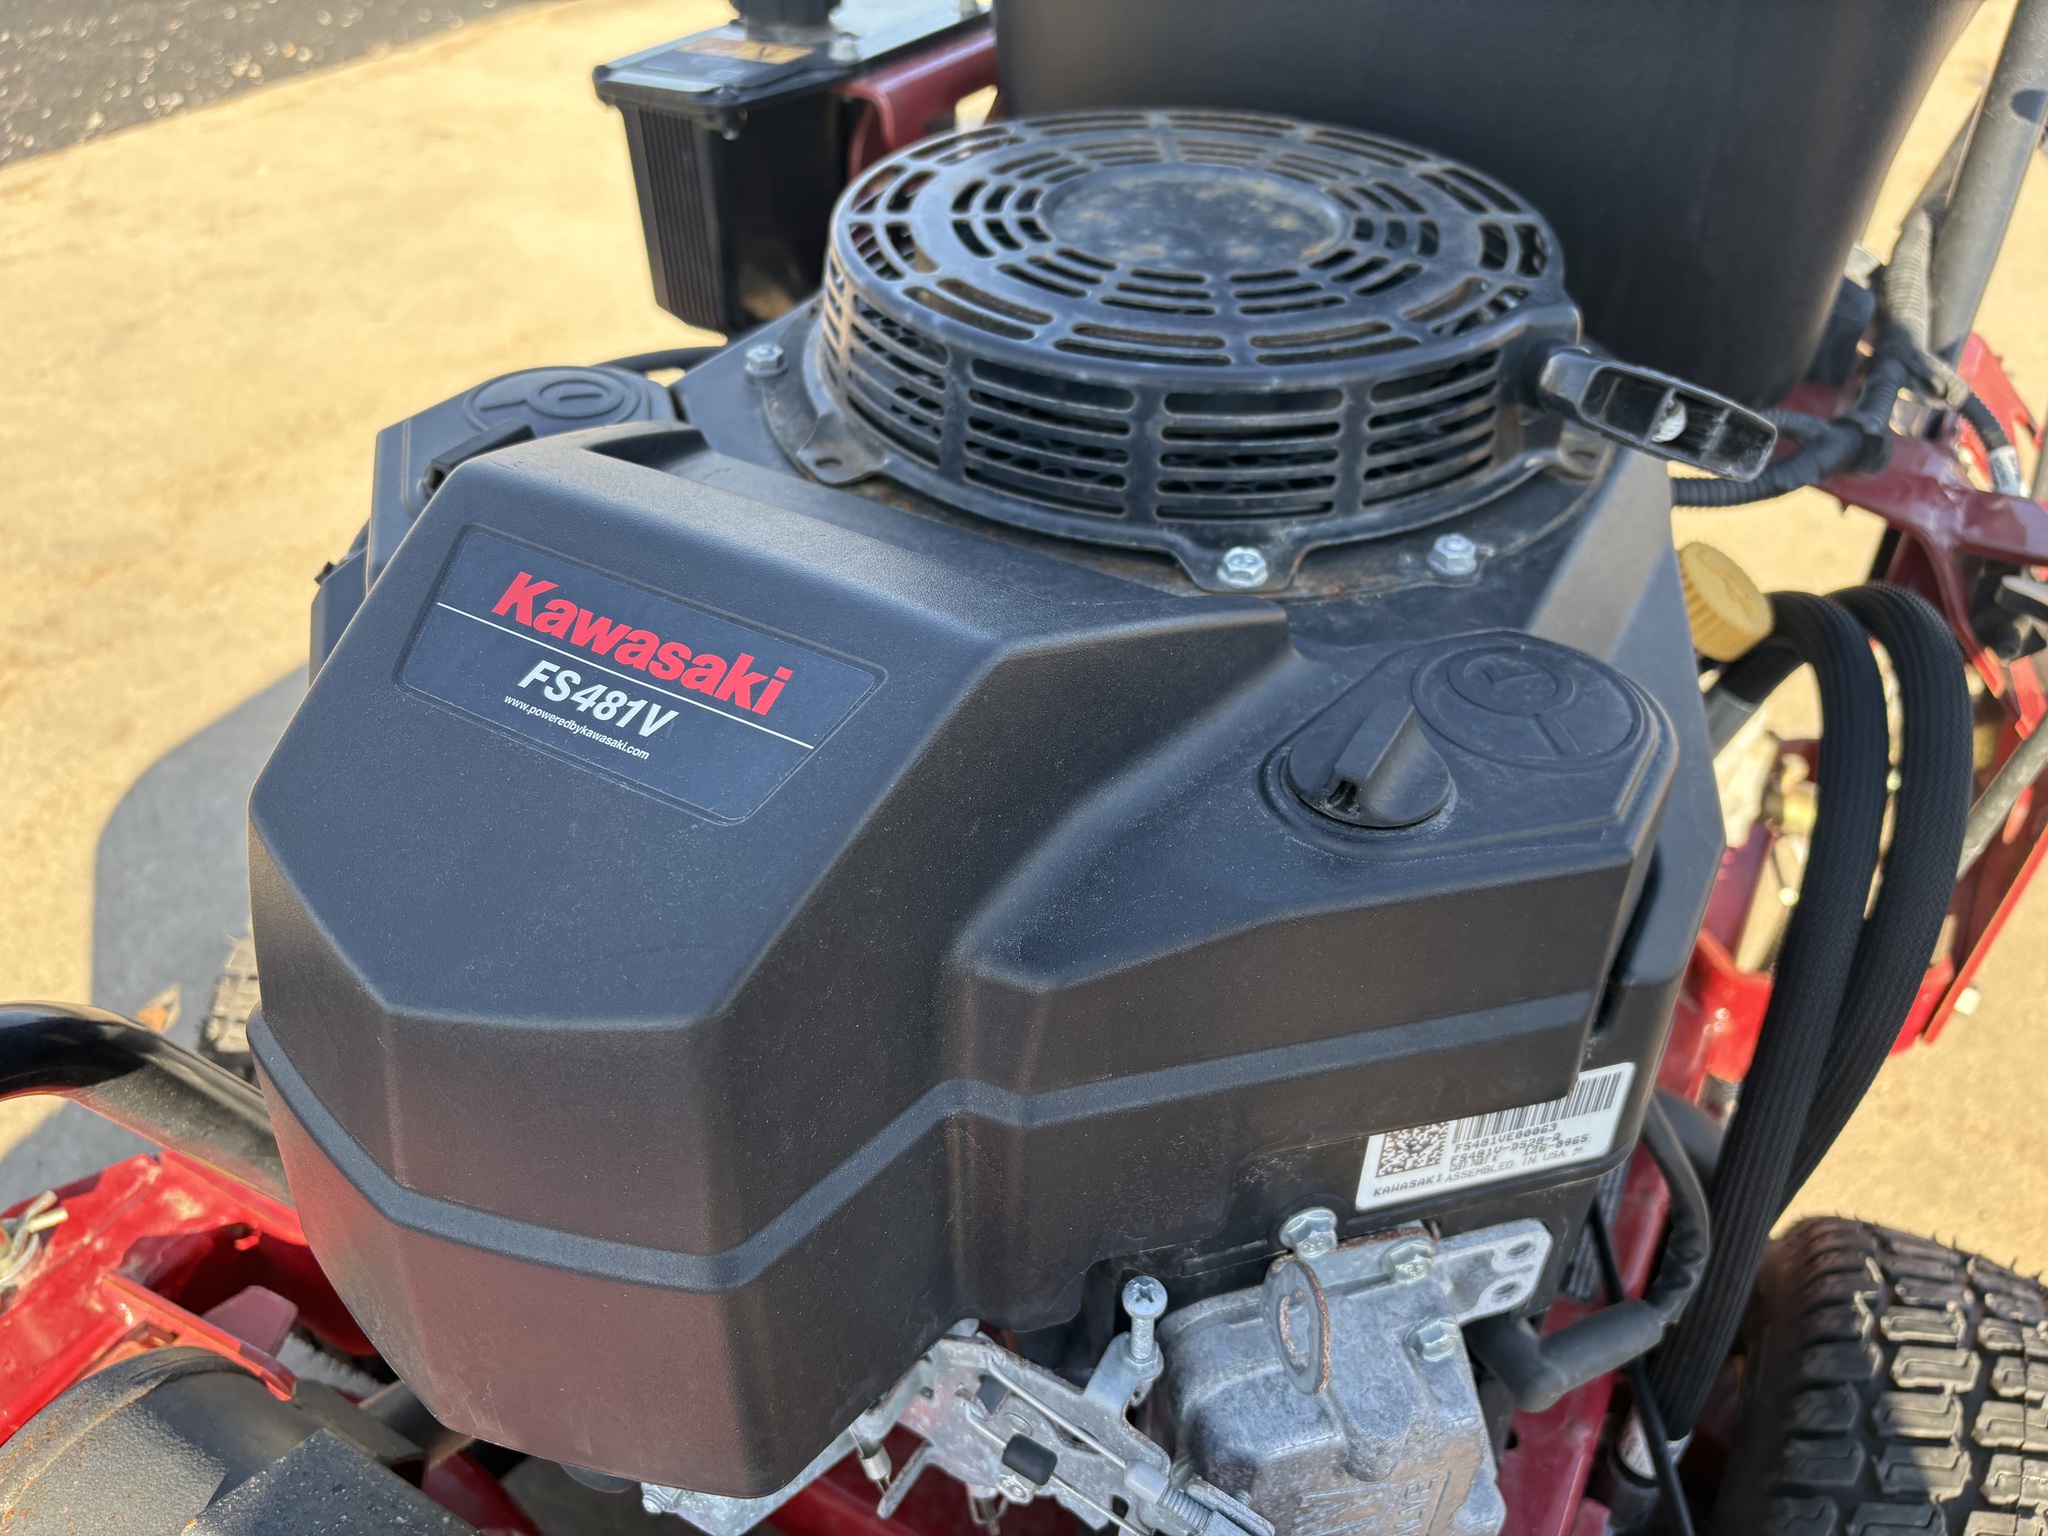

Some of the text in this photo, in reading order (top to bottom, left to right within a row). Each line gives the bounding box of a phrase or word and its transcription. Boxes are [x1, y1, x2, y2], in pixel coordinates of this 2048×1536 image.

[492, 571, 794, 716] Kawasaki
[503, 693, 651, 761] www.poweredbykawasaki.com
[517, 660, 680, 738] FS481V
[1373, 1173, 1443, 1197] KAWASAKI
[1445, 1160, 1514, 1183] ASSEMBLED
[1521, 1155, 1537, 1167] IN
[1542, 1150, 1565, 1161] USA
